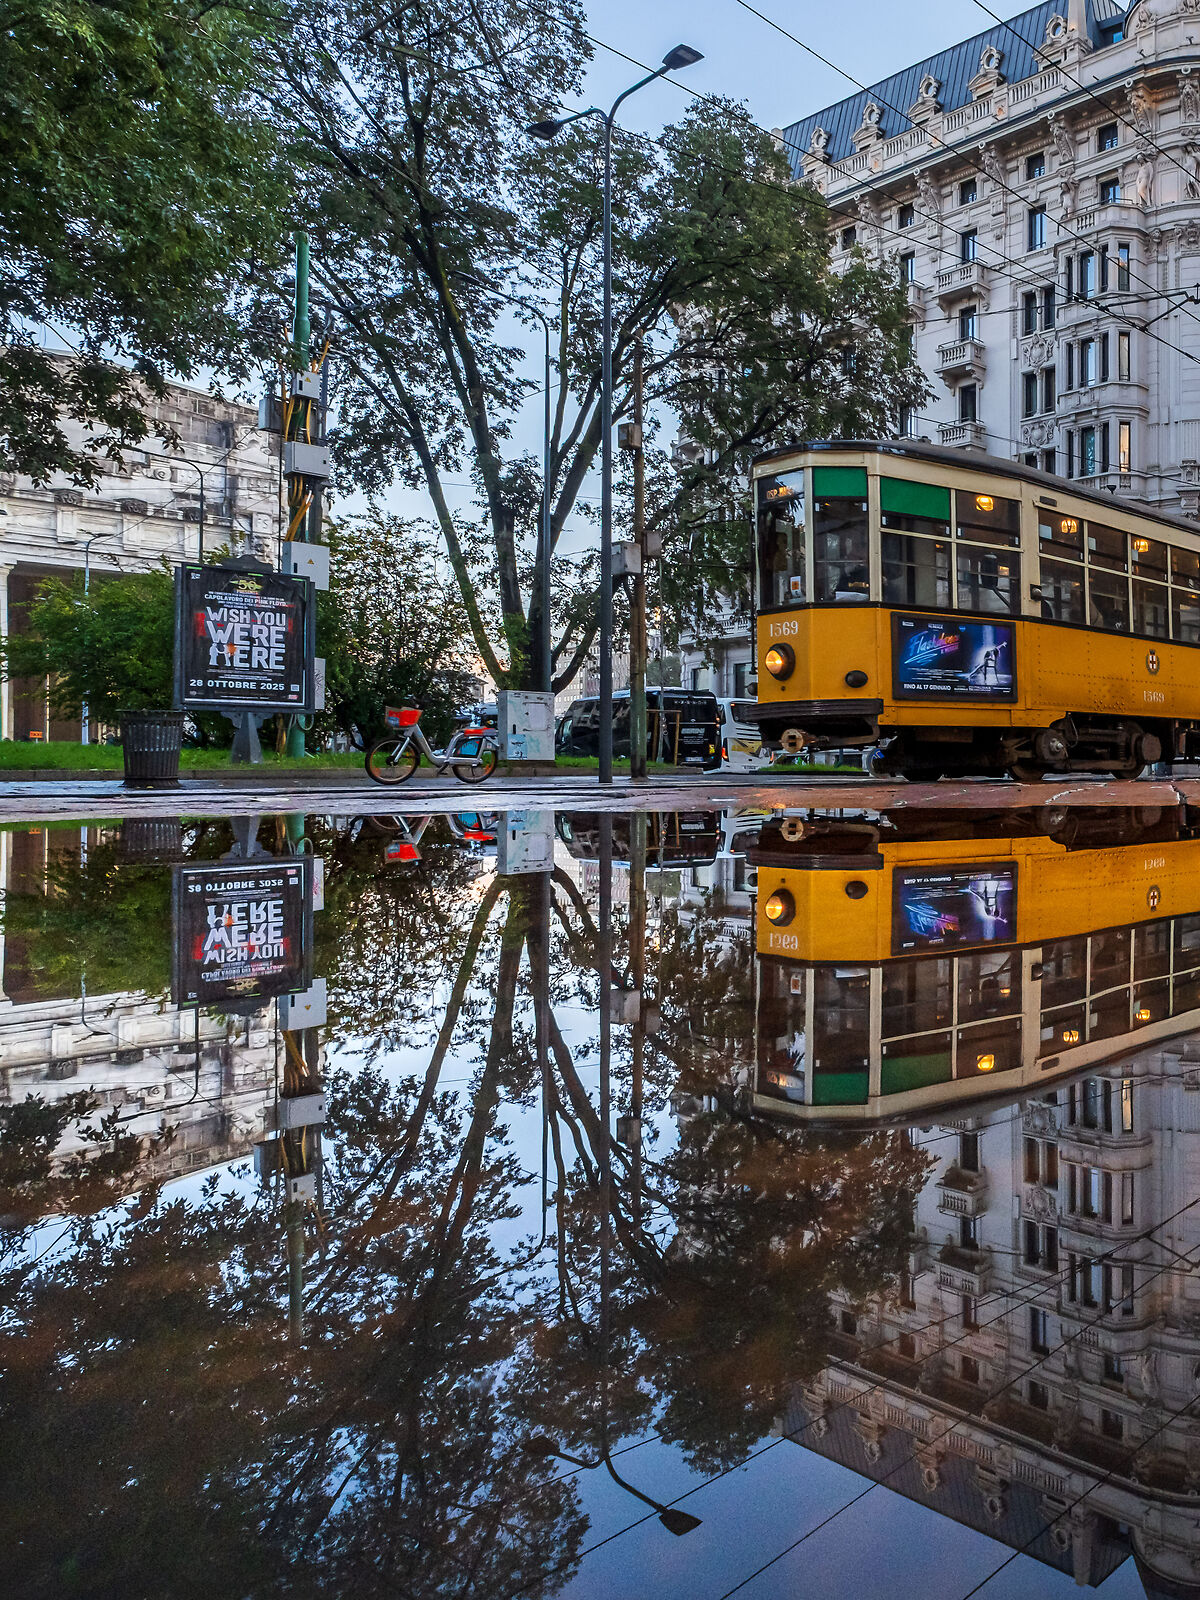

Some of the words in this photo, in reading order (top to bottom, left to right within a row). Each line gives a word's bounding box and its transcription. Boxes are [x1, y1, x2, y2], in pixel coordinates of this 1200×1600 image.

[205, 606, 251, 623] WISH
[253, 610, 286, 627] YOU
[206, 620, 286, 648] WERE
[770, 620, 798, 637] 1569
[209, 642, 286, 670] HERE
[189, 679, 203, 687] 28
[207, 680, 257, 690] OTTOBRE
[260, 682, 285, 691] 2025
[1143, 690, 1165, 703] 1569
